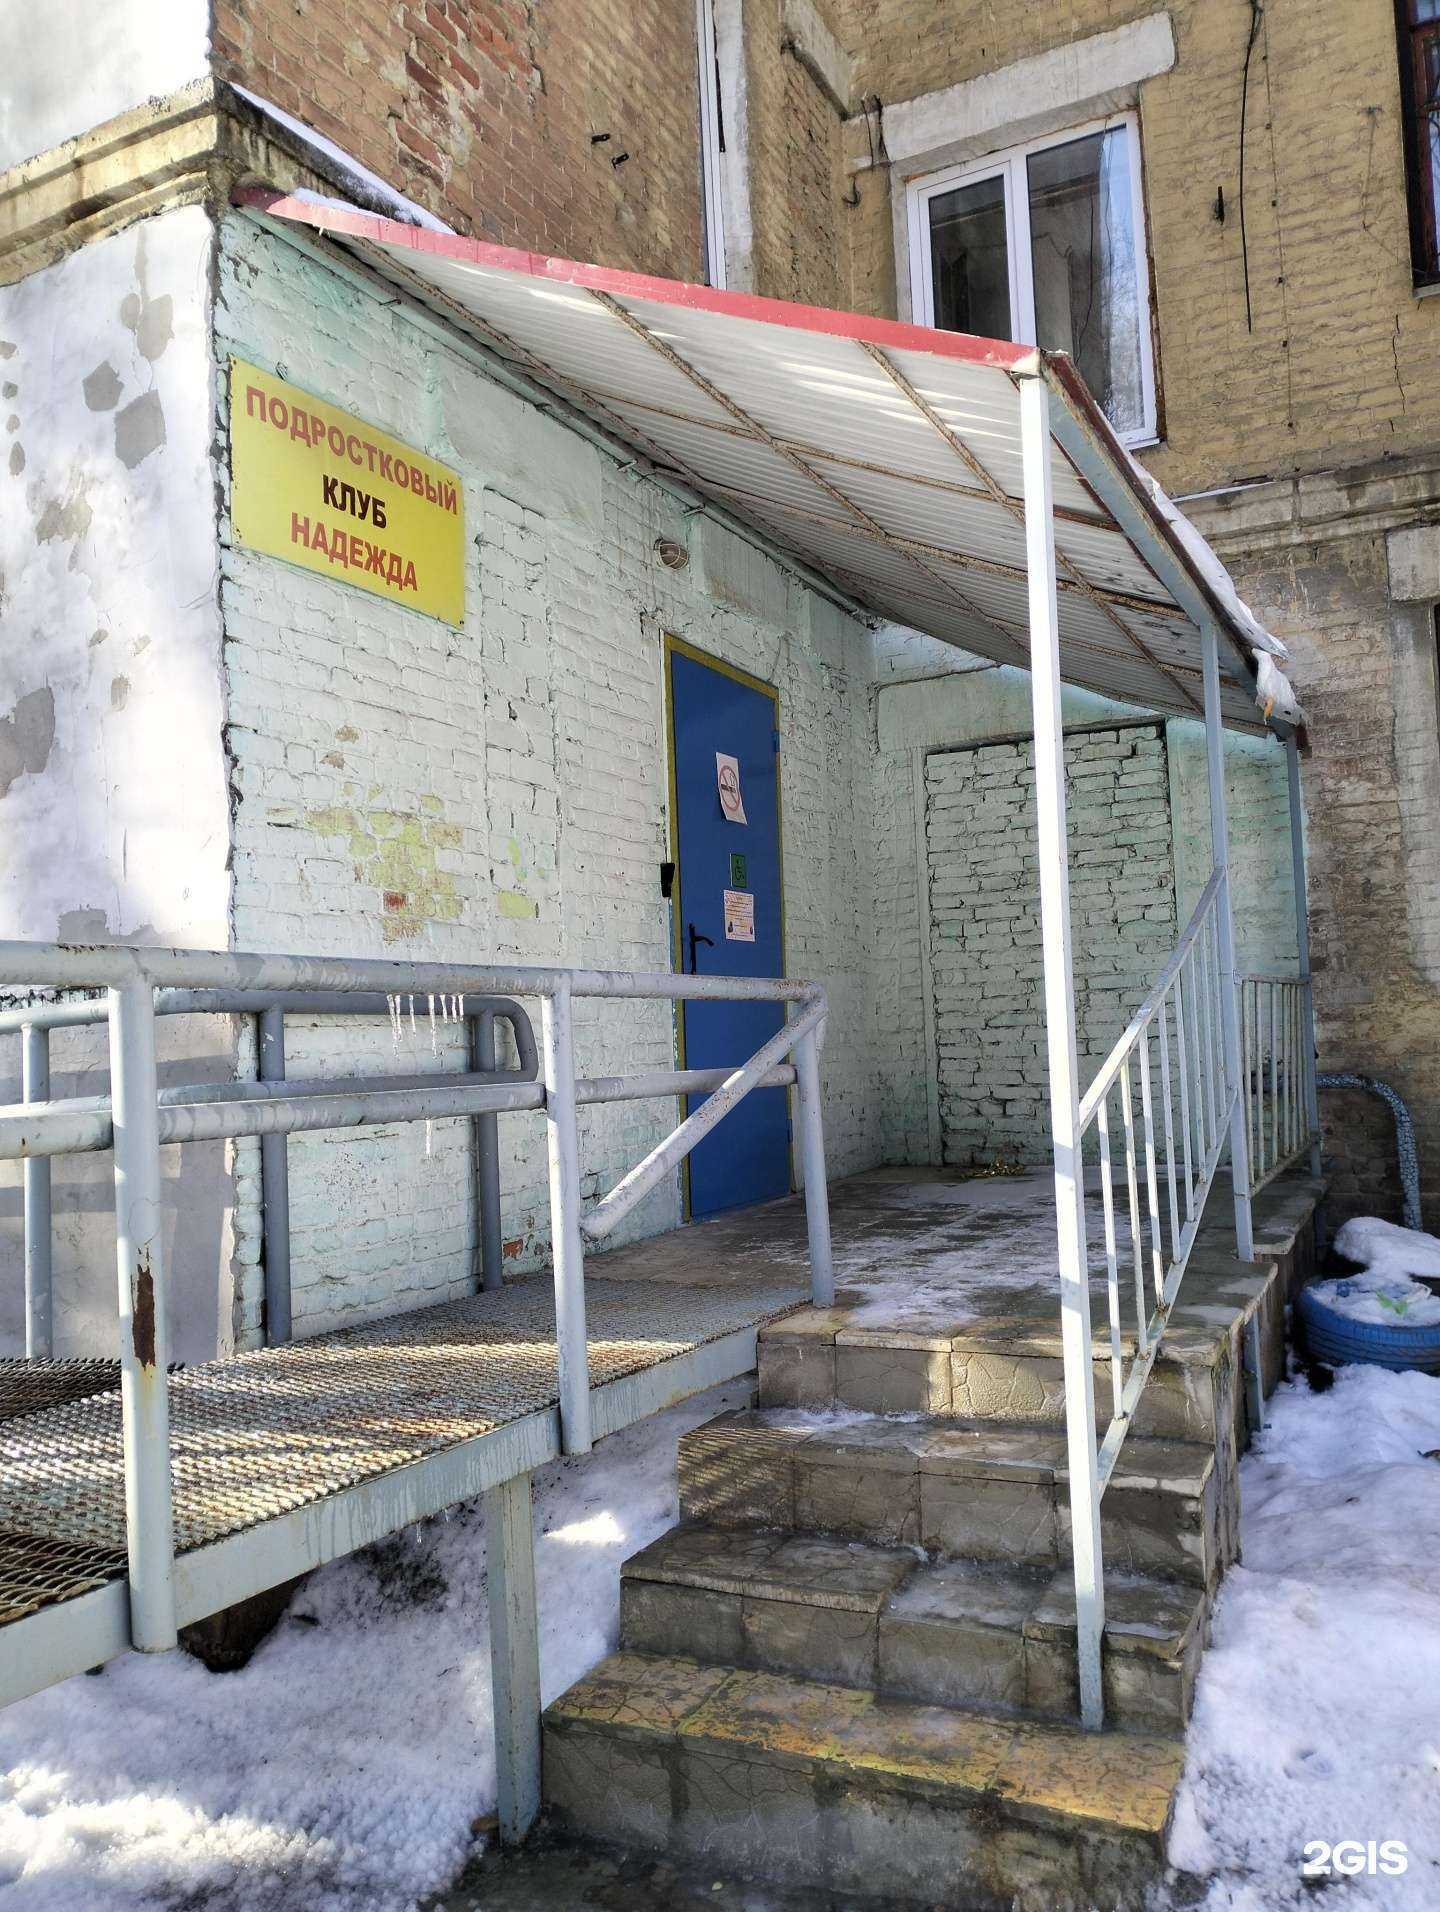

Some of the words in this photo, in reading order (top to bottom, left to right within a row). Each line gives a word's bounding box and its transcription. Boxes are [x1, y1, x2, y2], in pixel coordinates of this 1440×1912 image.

[246, 384, 458, 515] ПОДРОСТКОВЫЙ
[322, 474, 387, 529] КЛУБ
[290, 512, 418, 591] НАДЕЖДА
